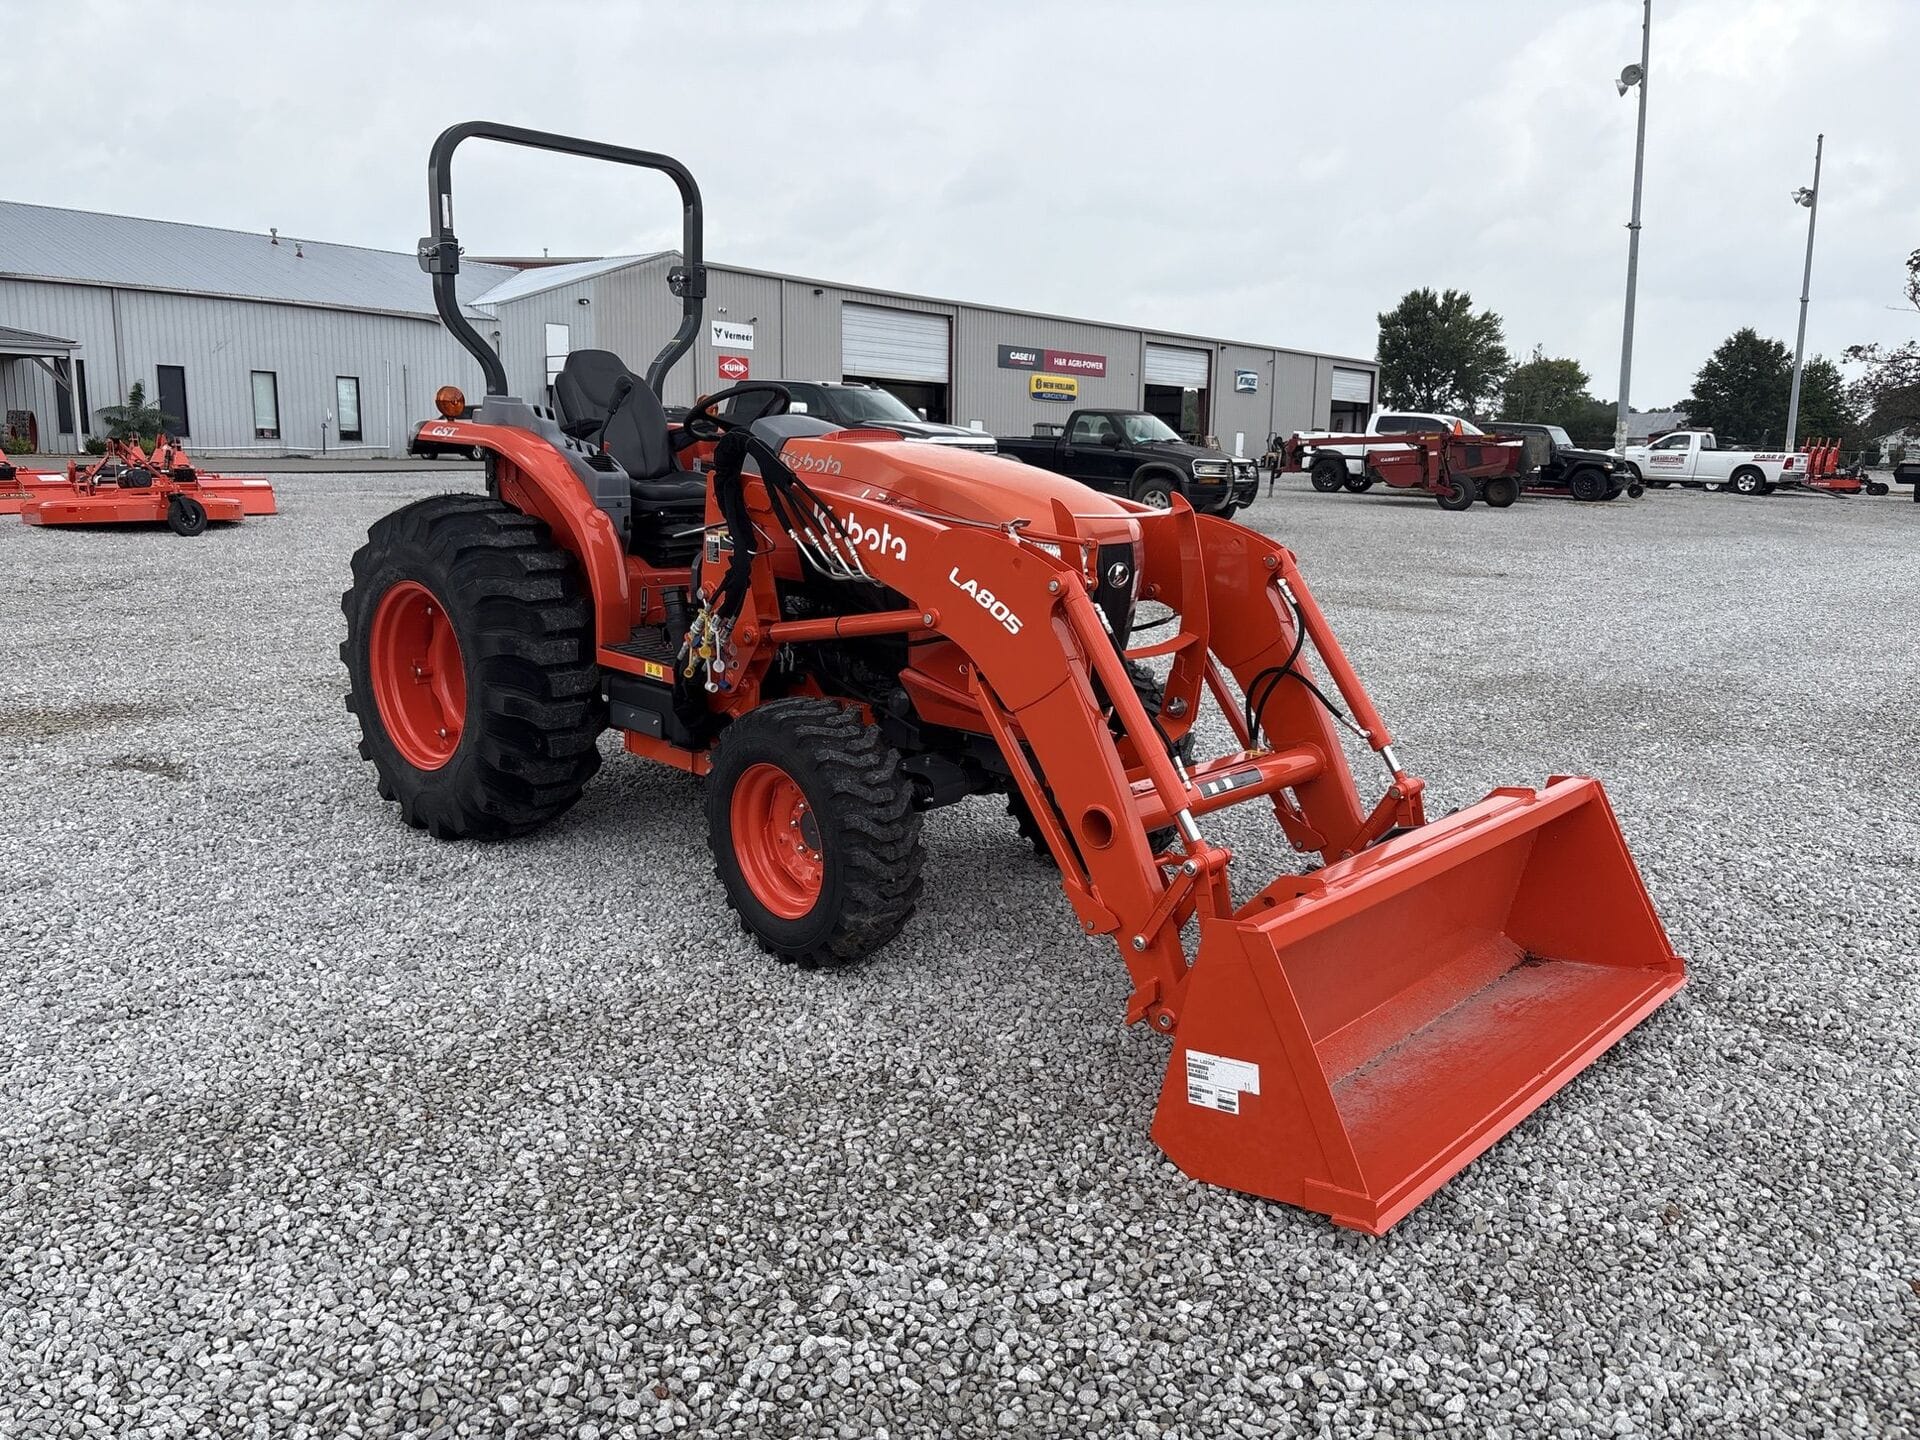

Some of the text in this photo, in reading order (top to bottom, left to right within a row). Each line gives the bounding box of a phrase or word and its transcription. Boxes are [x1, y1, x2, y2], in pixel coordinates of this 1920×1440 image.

[724, 330, 752, 341] Vermeer
[1010, 351, 1029, 361] CASE
[724, 363, 744, 372] KUHN
[1043, 381, 1075, 391] NEW HOLLAND
[432, 426, 459, 437] GST
[949, 566, 1024, 635] LA805
